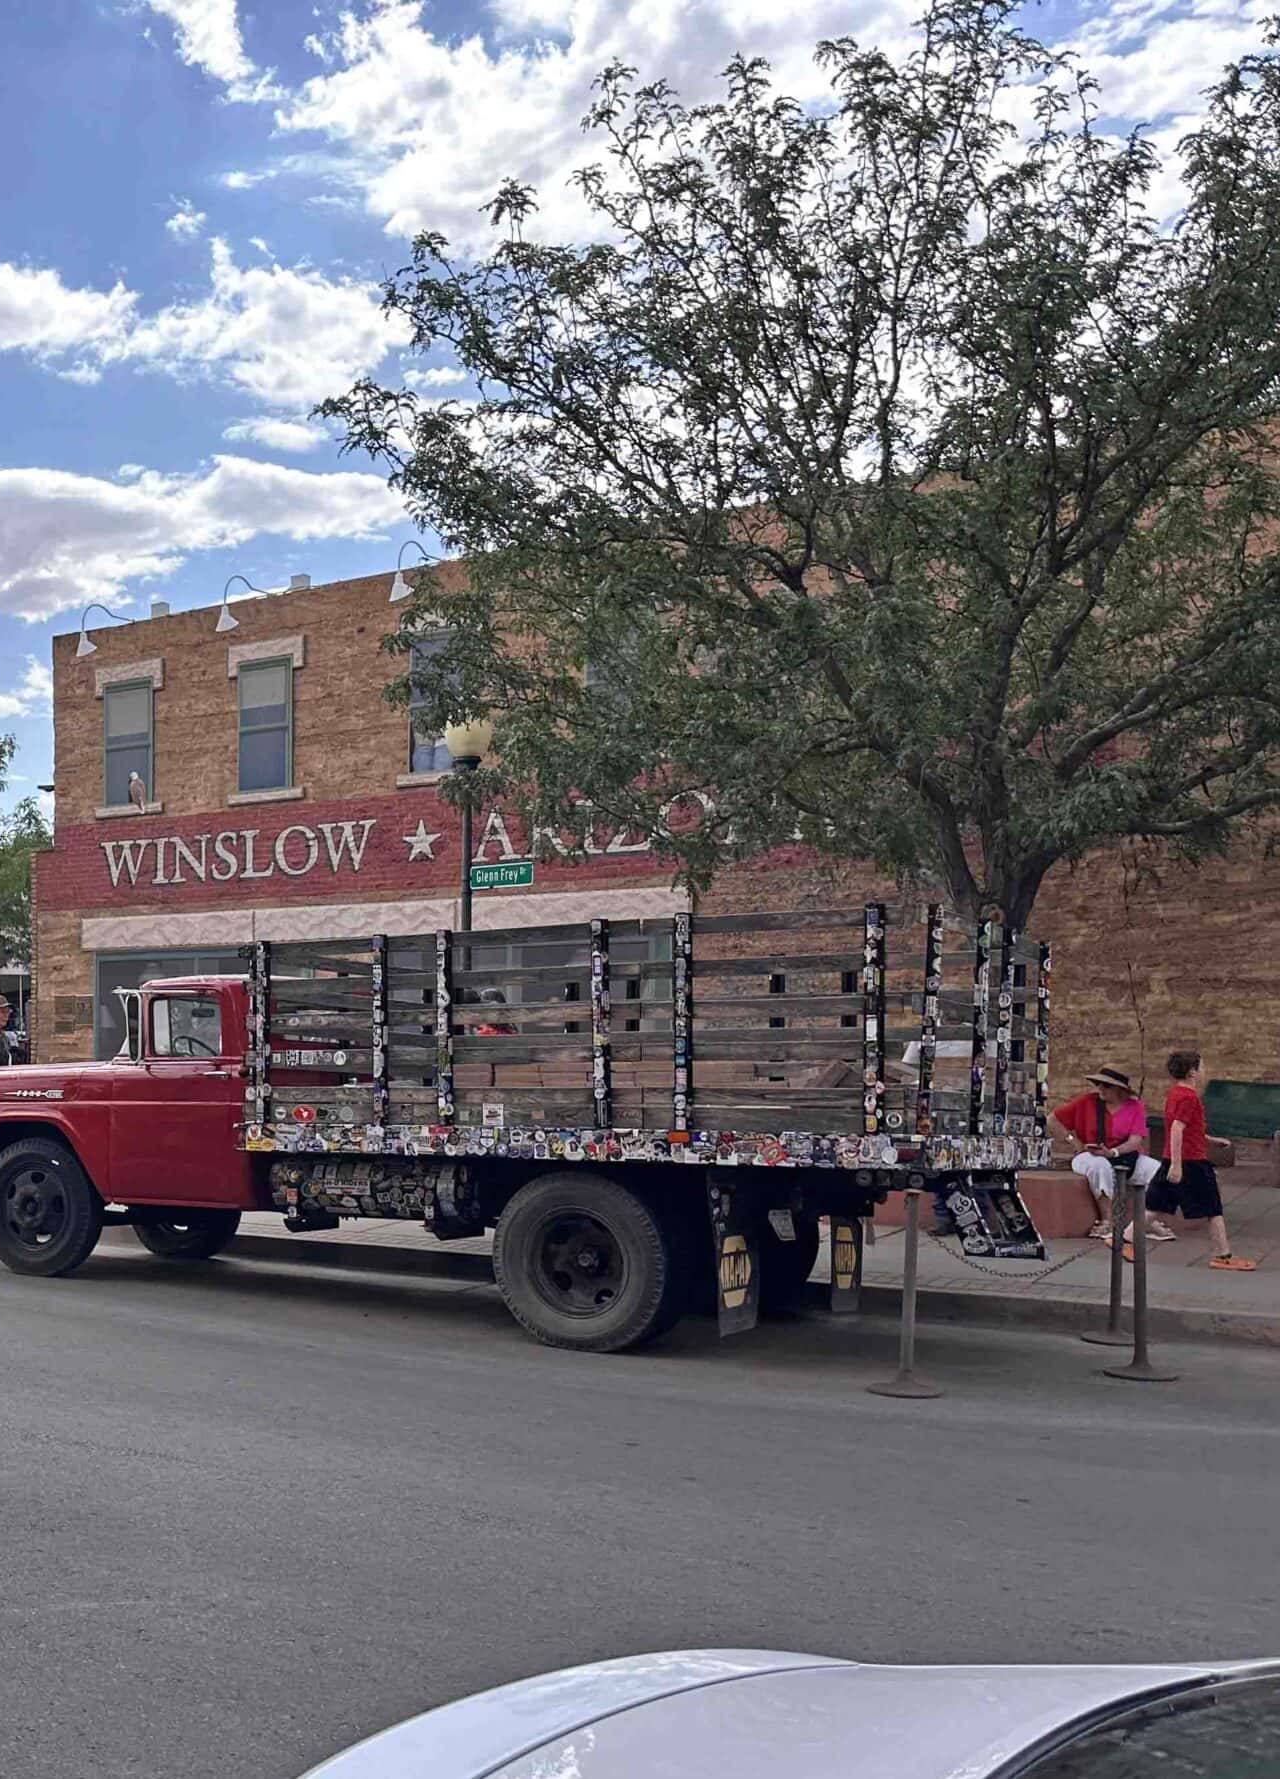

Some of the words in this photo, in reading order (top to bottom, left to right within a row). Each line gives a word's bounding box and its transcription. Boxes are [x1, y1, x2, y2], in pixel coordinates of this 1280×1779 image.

[100, 819, 377, 888] WINSLOW
[476, 869, 499, 884] Glenn
[500, 867, 519, 884] Frey
